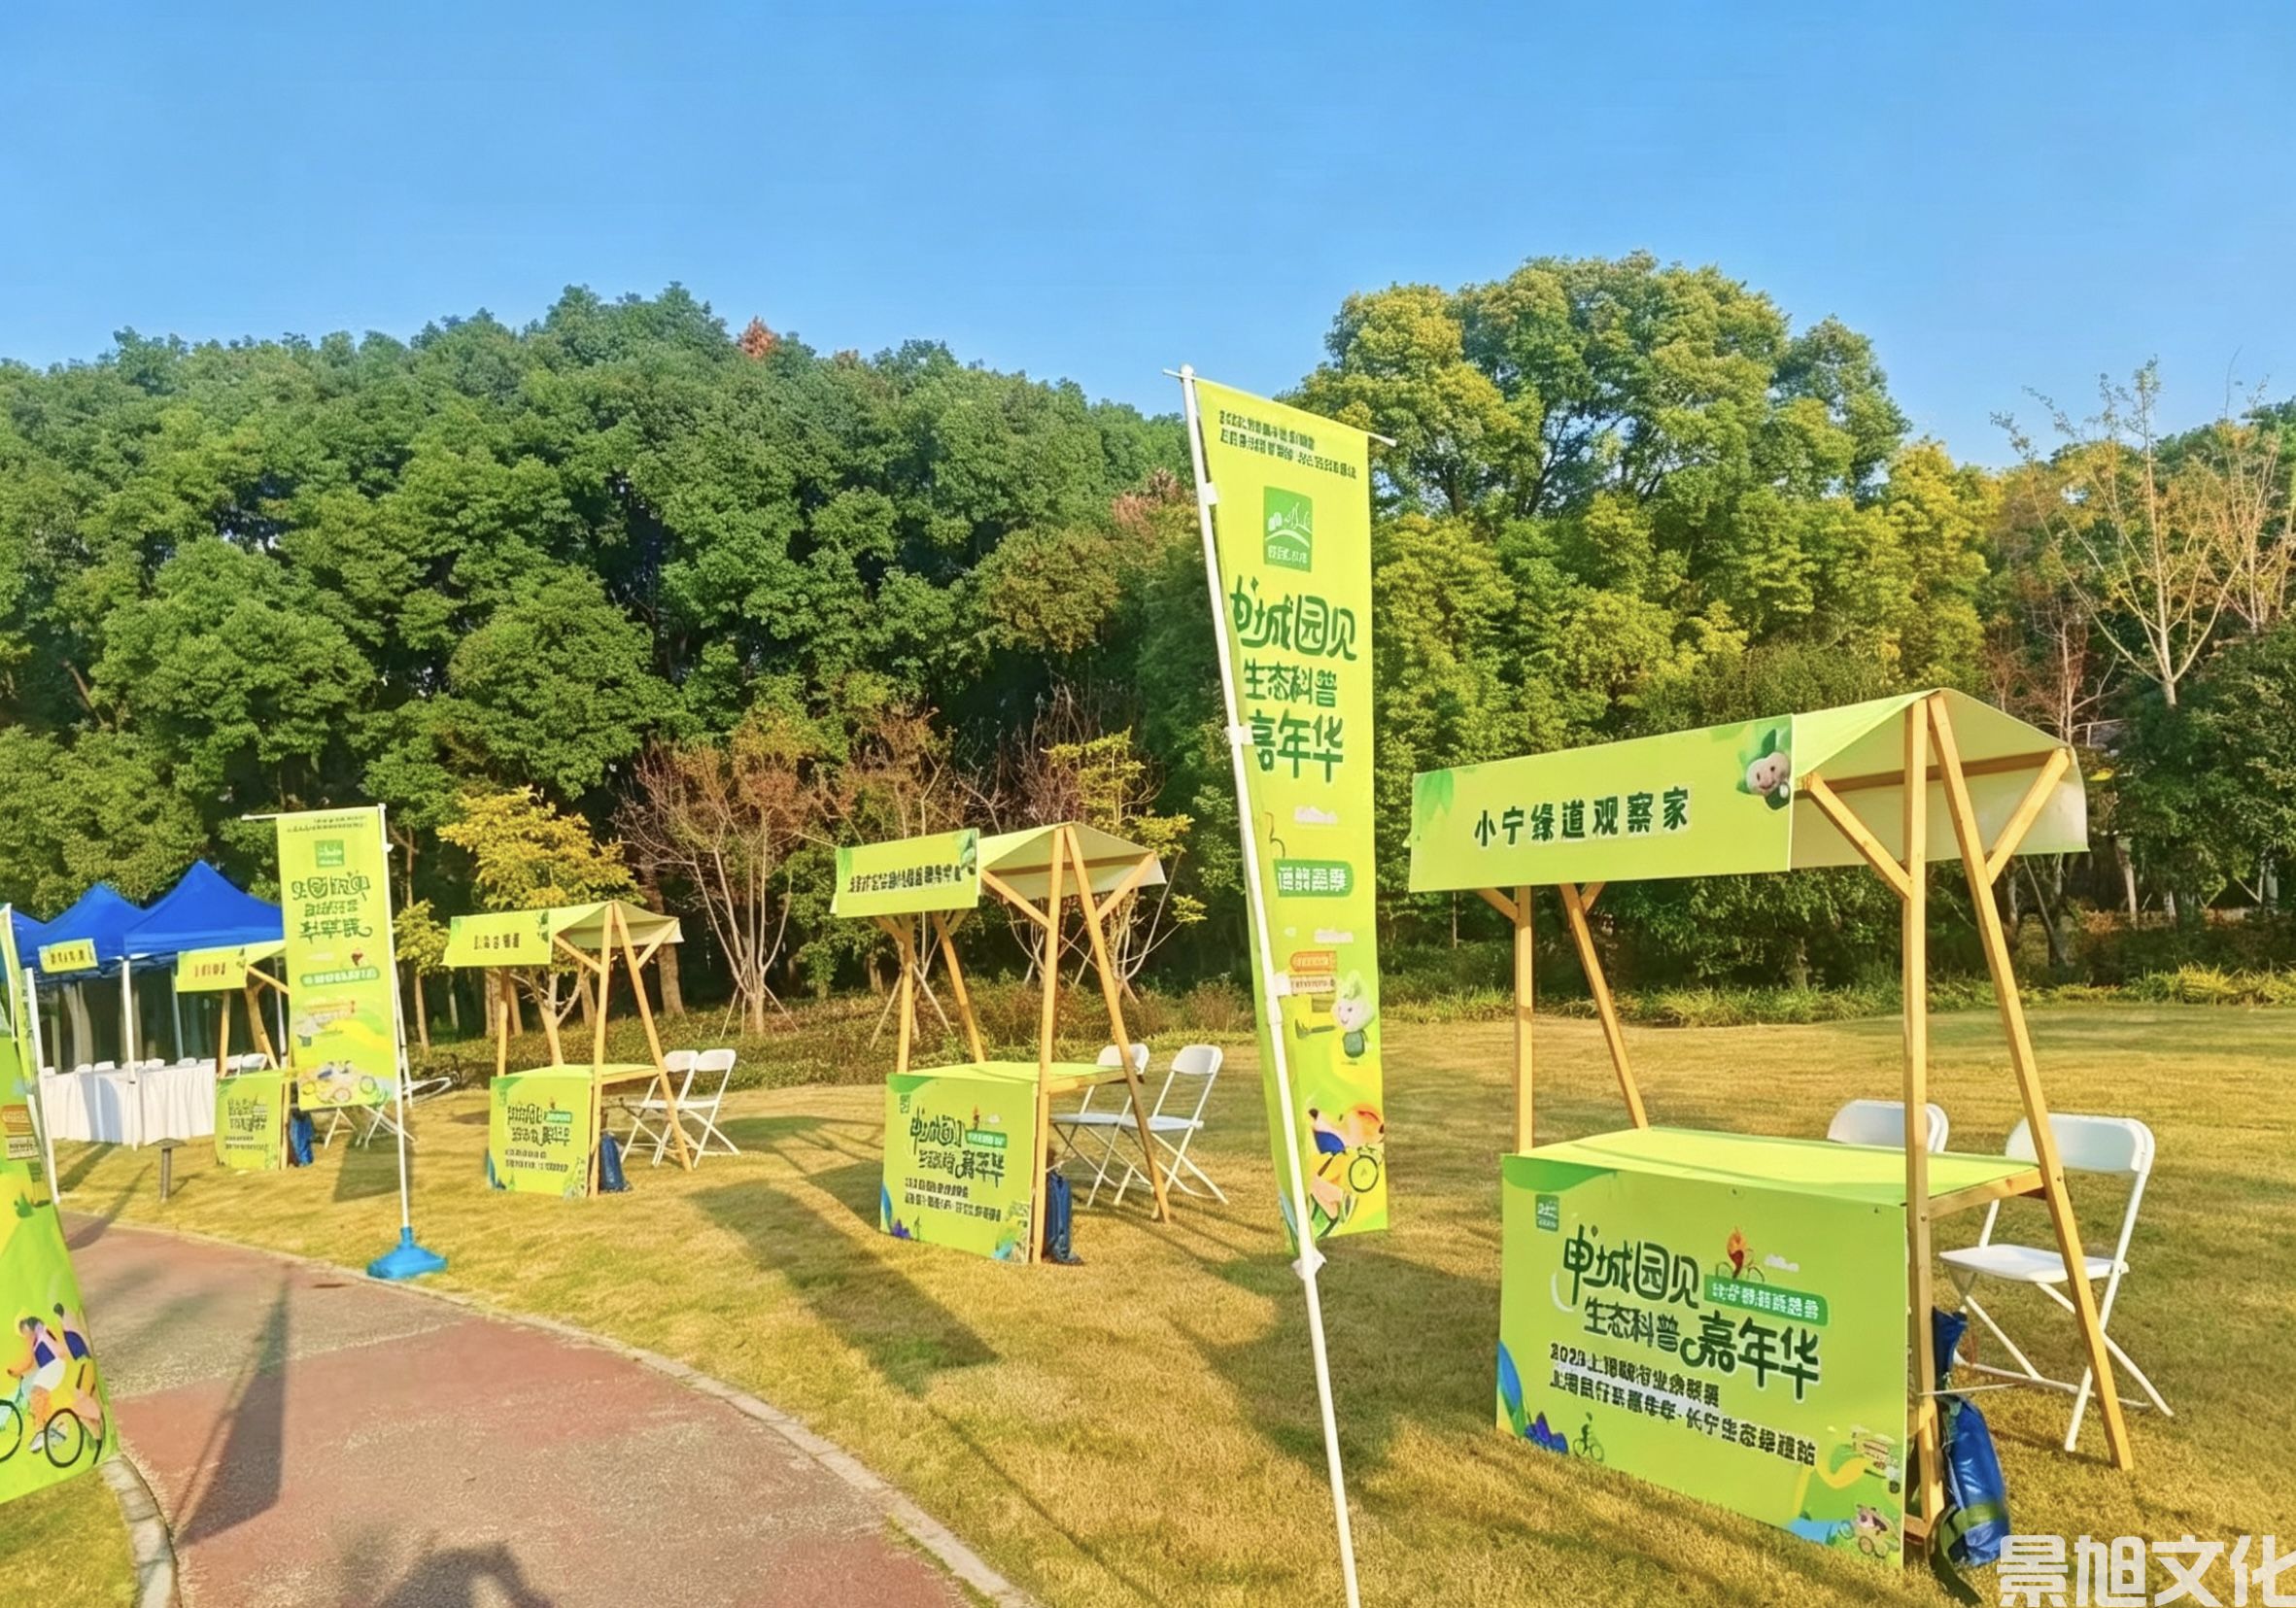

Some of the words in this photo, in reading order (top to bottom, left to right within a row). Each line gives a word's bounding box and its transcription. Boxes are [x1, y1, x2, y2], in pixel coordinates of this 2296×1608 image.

[1563, 1224, 1699, 1306] 申城园见
[1584, 1295, 1680, 1352] 生态科普
[1680, 1310, 1819, 1400] 嘉年华
